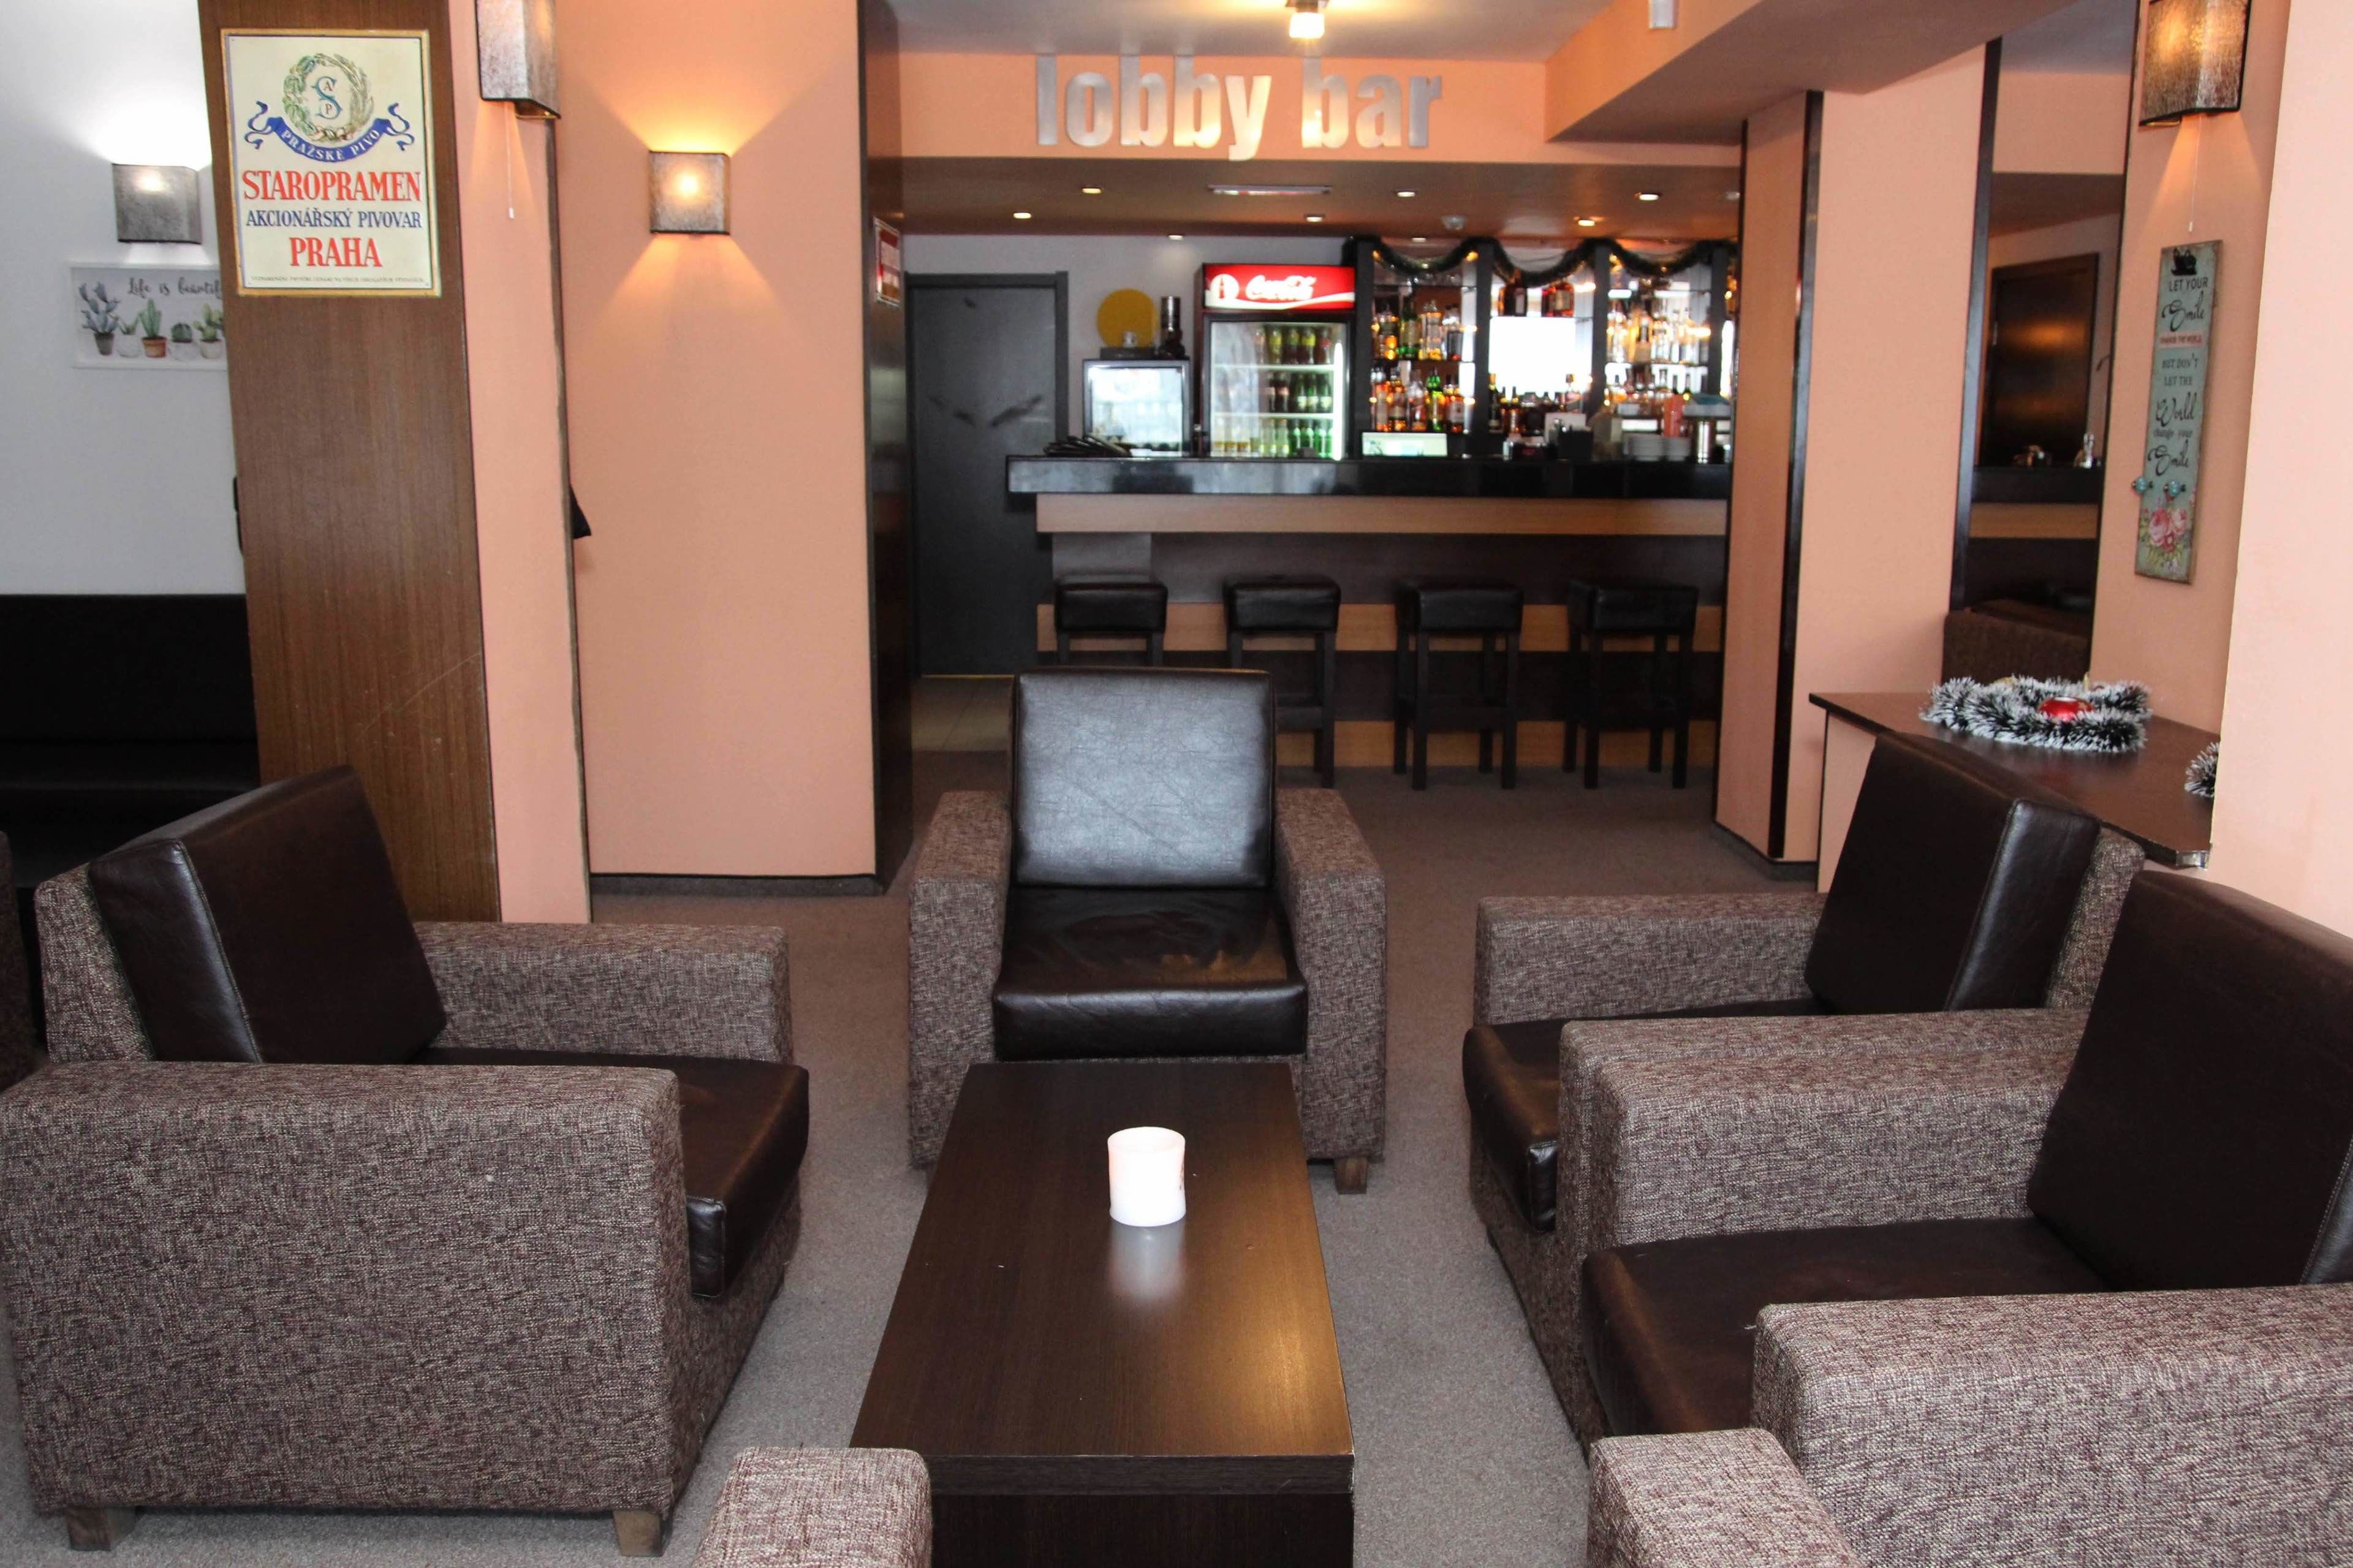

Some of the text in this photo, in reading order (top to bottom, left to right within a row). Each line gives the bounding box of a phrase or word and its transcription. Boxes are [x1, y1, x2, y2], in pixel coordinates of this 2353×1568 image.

[1036, 53, 1442, 162] lobby bar
[350, 129, 380, 156] PIVO
[243, 170, 422, 202] STAROPRAMEN
[246, 207, 422, 228] AKCIONÁŘSKÝ PIVOVAR
[289, 237, 382, 268] PRAHA
[127, 276, 222, 300] Life is beautif
[2169, 277, 2208, 292] LET YOUR
[2161, 290, 2204, 332] Smile
[2164, 376, 2178, 387] LET
[2156, 391, 2197, 428] World
[2147, 439, 2189, 477] Smile
